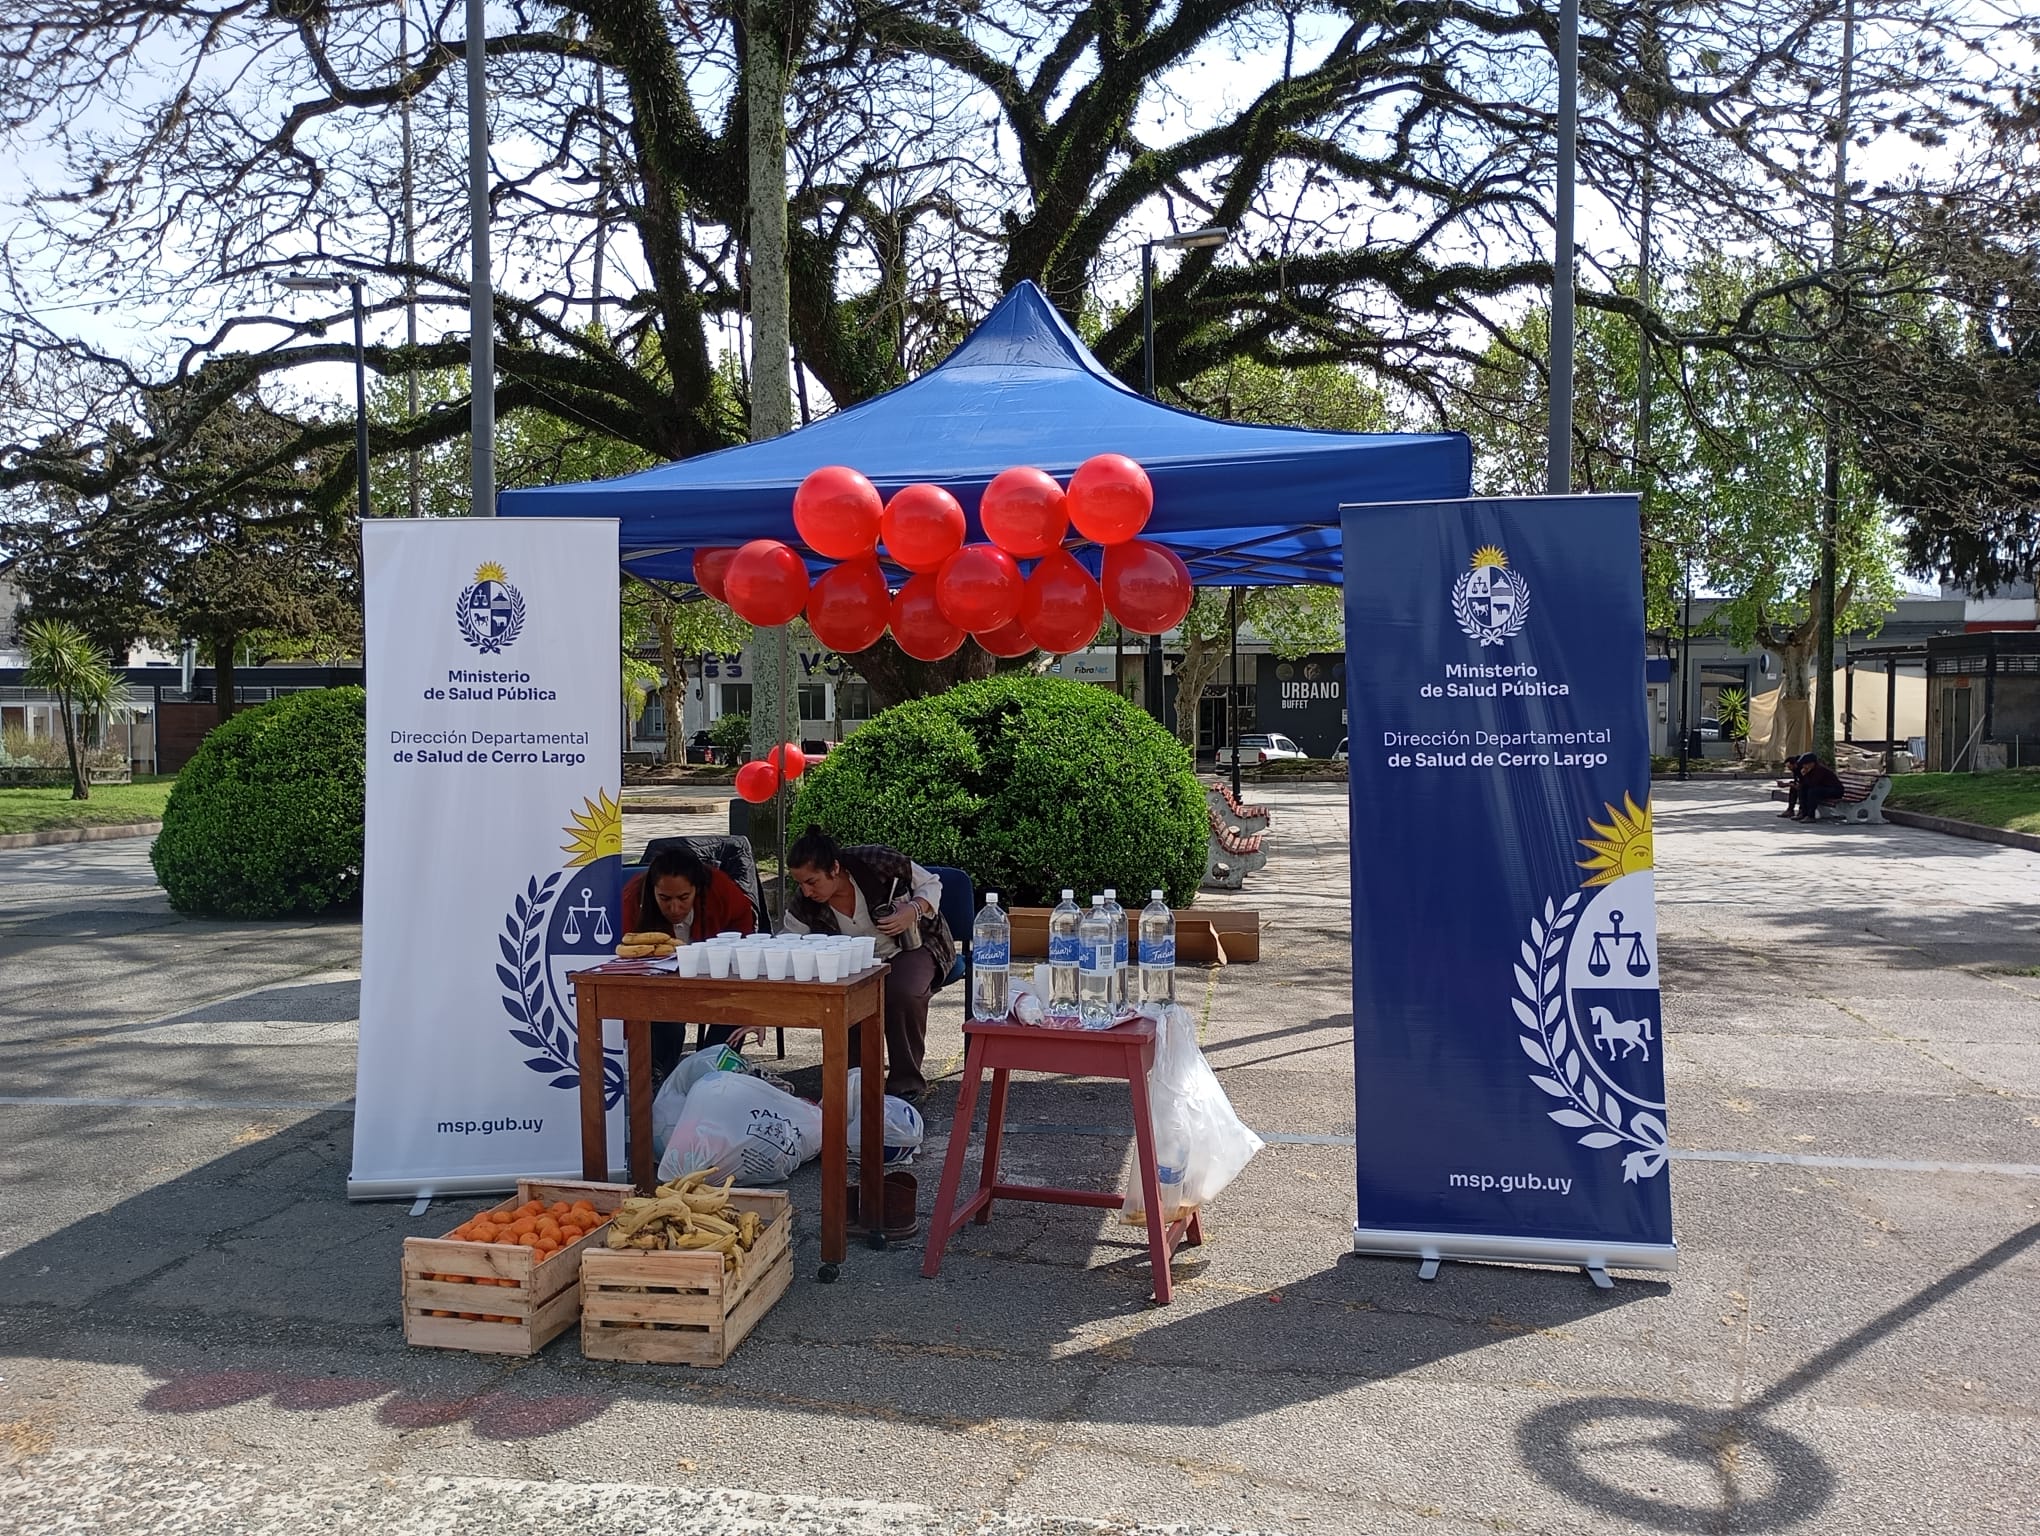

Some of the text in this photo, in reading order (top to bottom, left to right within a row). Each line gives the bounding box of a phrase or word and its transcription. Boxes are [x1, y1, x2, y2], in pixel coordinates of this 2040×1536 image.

[448, 670, 530, 684] Ministerio
[1446, 662, 1538, 679] Ministerio
[423, 686, 557, 701] de Salud Pública
[1281, 681, 1340, 699] URBANO
[1420, 678, 1570, 698] de Salud Pública
[1281, 699, 1309, 710] BUFFET
[390, 730, 589, 747] Dirección Departamental
[1383, 727, 1612, 749] Dirección Departamental
[393, 749, 586, 767] de Salud de Cerro Largo
[1387, 751, 1608, 770] de Salud de Cerro Largo
[437, 1117, 544, 1136] msp.gub.uy
[1449, 1173, 1572, 1195] msp.gub.uy
